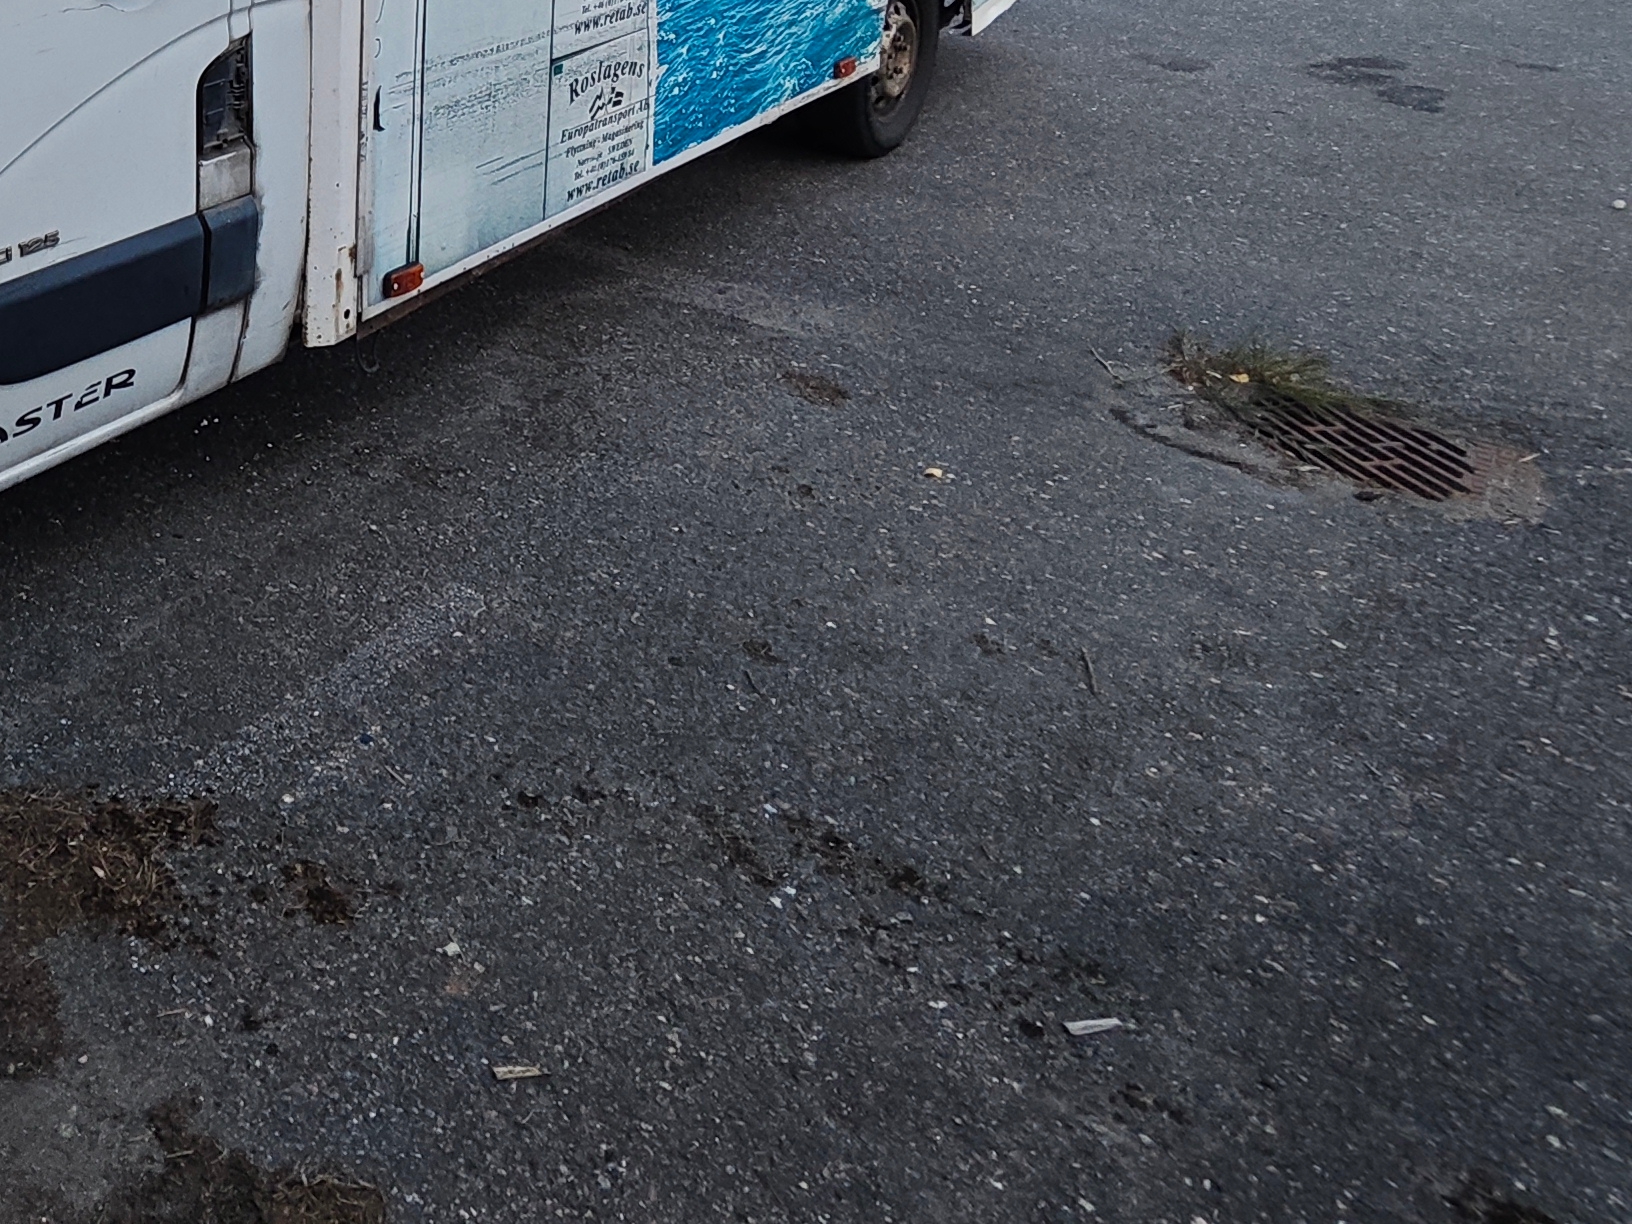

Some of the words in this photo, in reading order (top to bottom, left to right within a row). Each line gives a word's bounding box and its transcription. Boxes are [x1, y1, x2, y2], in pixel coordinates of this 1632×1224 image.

[574, 1, 648, 35] www.retab.se
[569, 60, 645, 105] Roslagens
[560, 105, 636, 144] Europatransport
[567, 159, 640, 202] www.retab.se
[18, 229, 60, 258] 125
